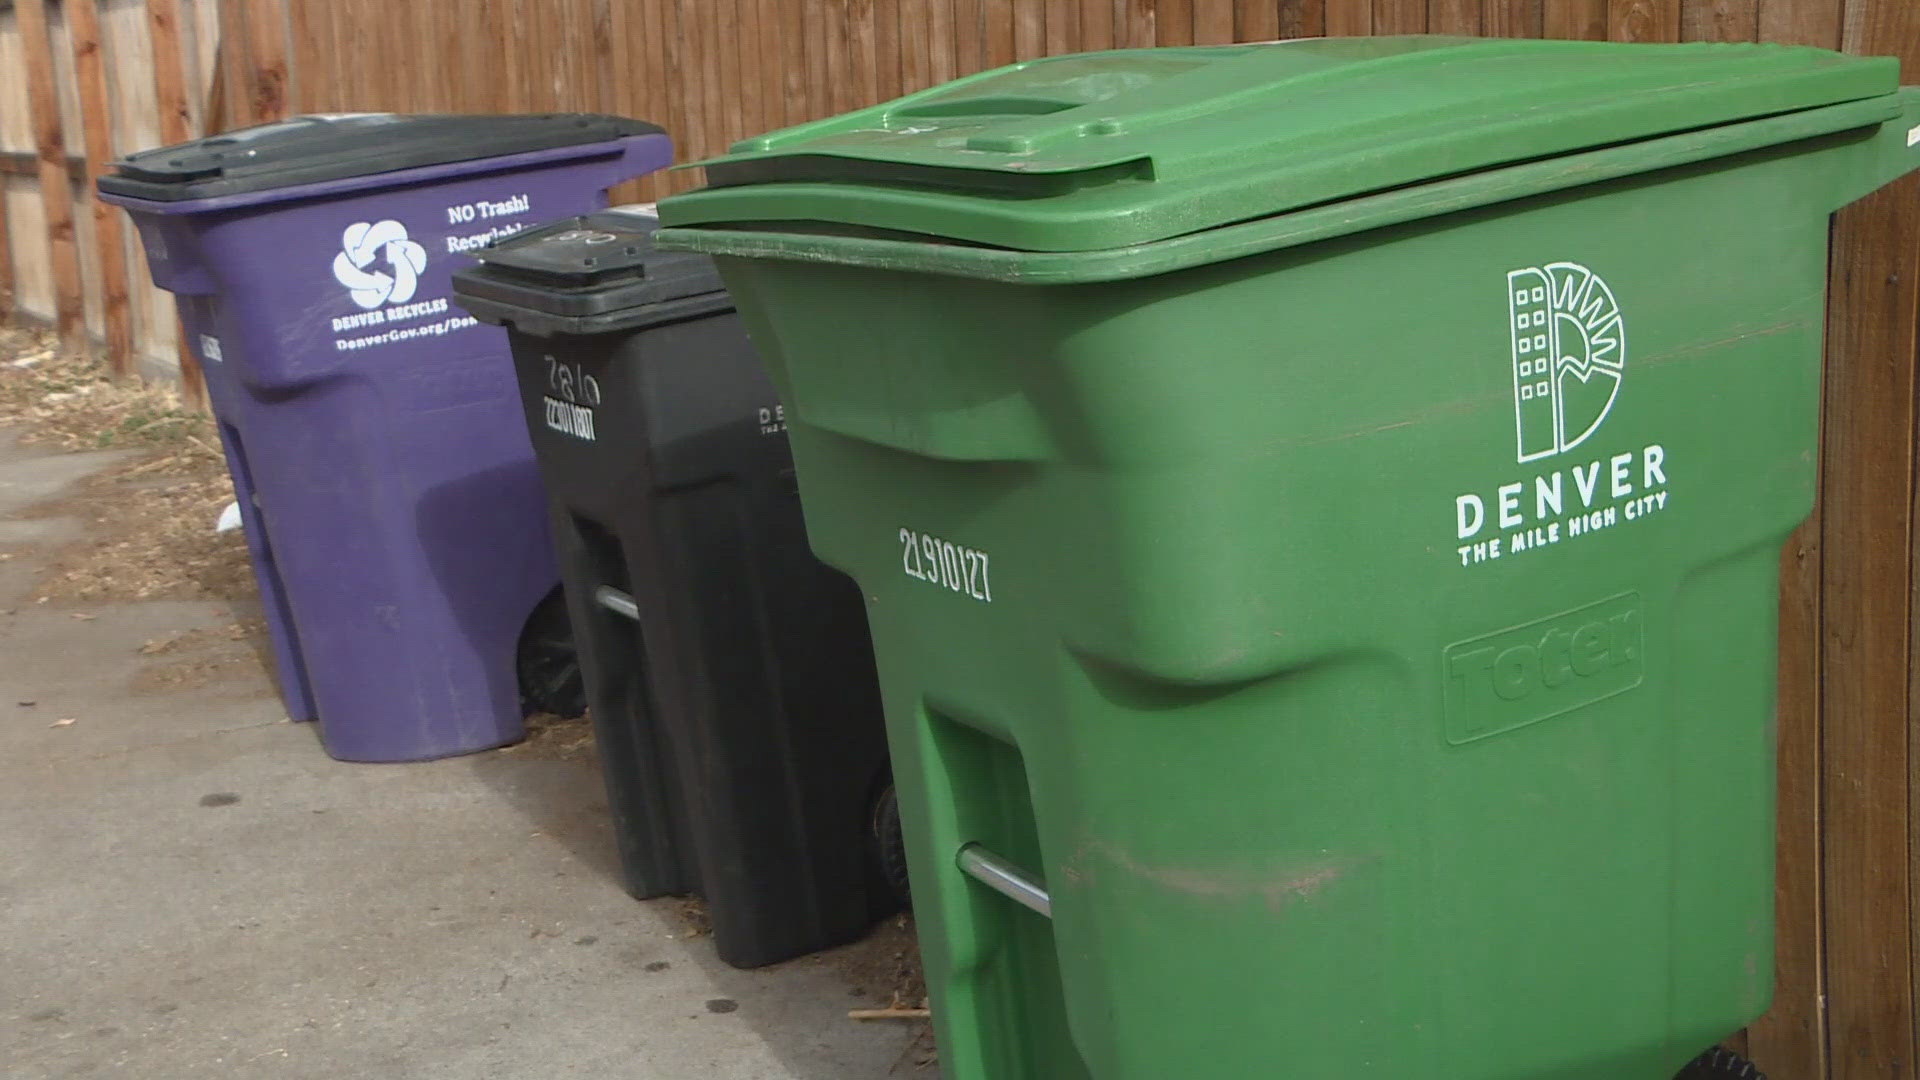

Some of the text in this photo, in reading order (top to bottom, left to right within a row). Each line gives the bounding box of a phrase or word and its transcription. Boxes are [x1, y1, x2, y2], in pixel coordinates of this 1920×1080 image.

[447, 193, 530, 224] NO Trash!
[332, 298, 448, 332] DENVER RECYCLES
[1456, 444, 1667, 539] DENVER
[1458, 491, 1667, 567] THE MILE HIGH CITY
[900, 527, 992, 602] 21910127
